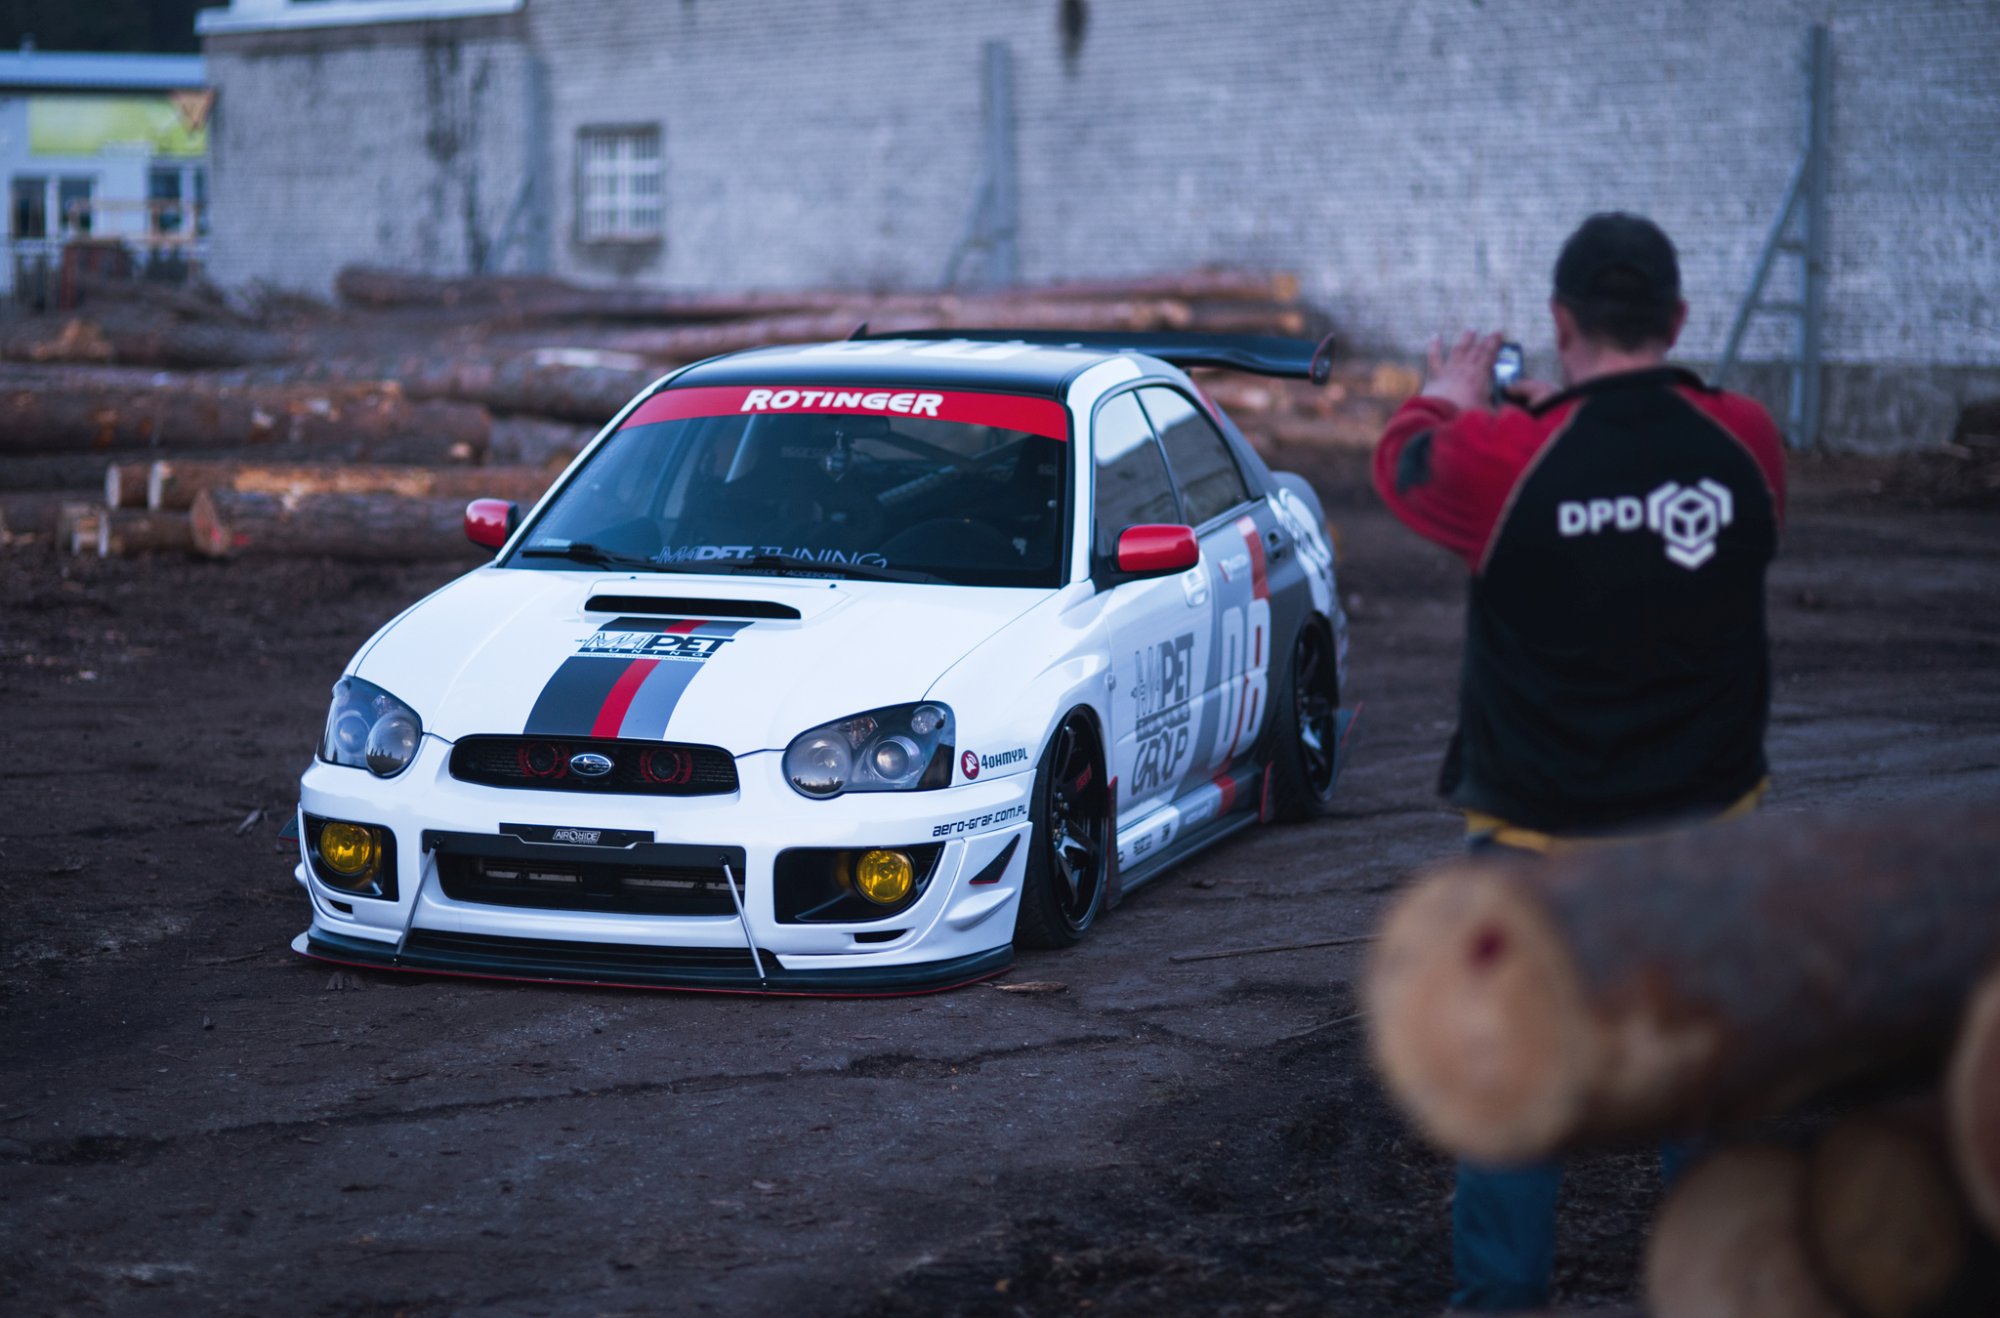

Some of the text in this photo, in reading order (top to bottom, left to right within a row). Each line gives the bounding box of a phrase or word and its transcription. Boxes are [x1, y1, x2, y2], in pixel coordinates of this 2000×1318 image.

[740, 389, 944, 417] ROTINGER
[1557, 496, 1644, 536] DPD
[589, 647, 704, 657] TUNING
